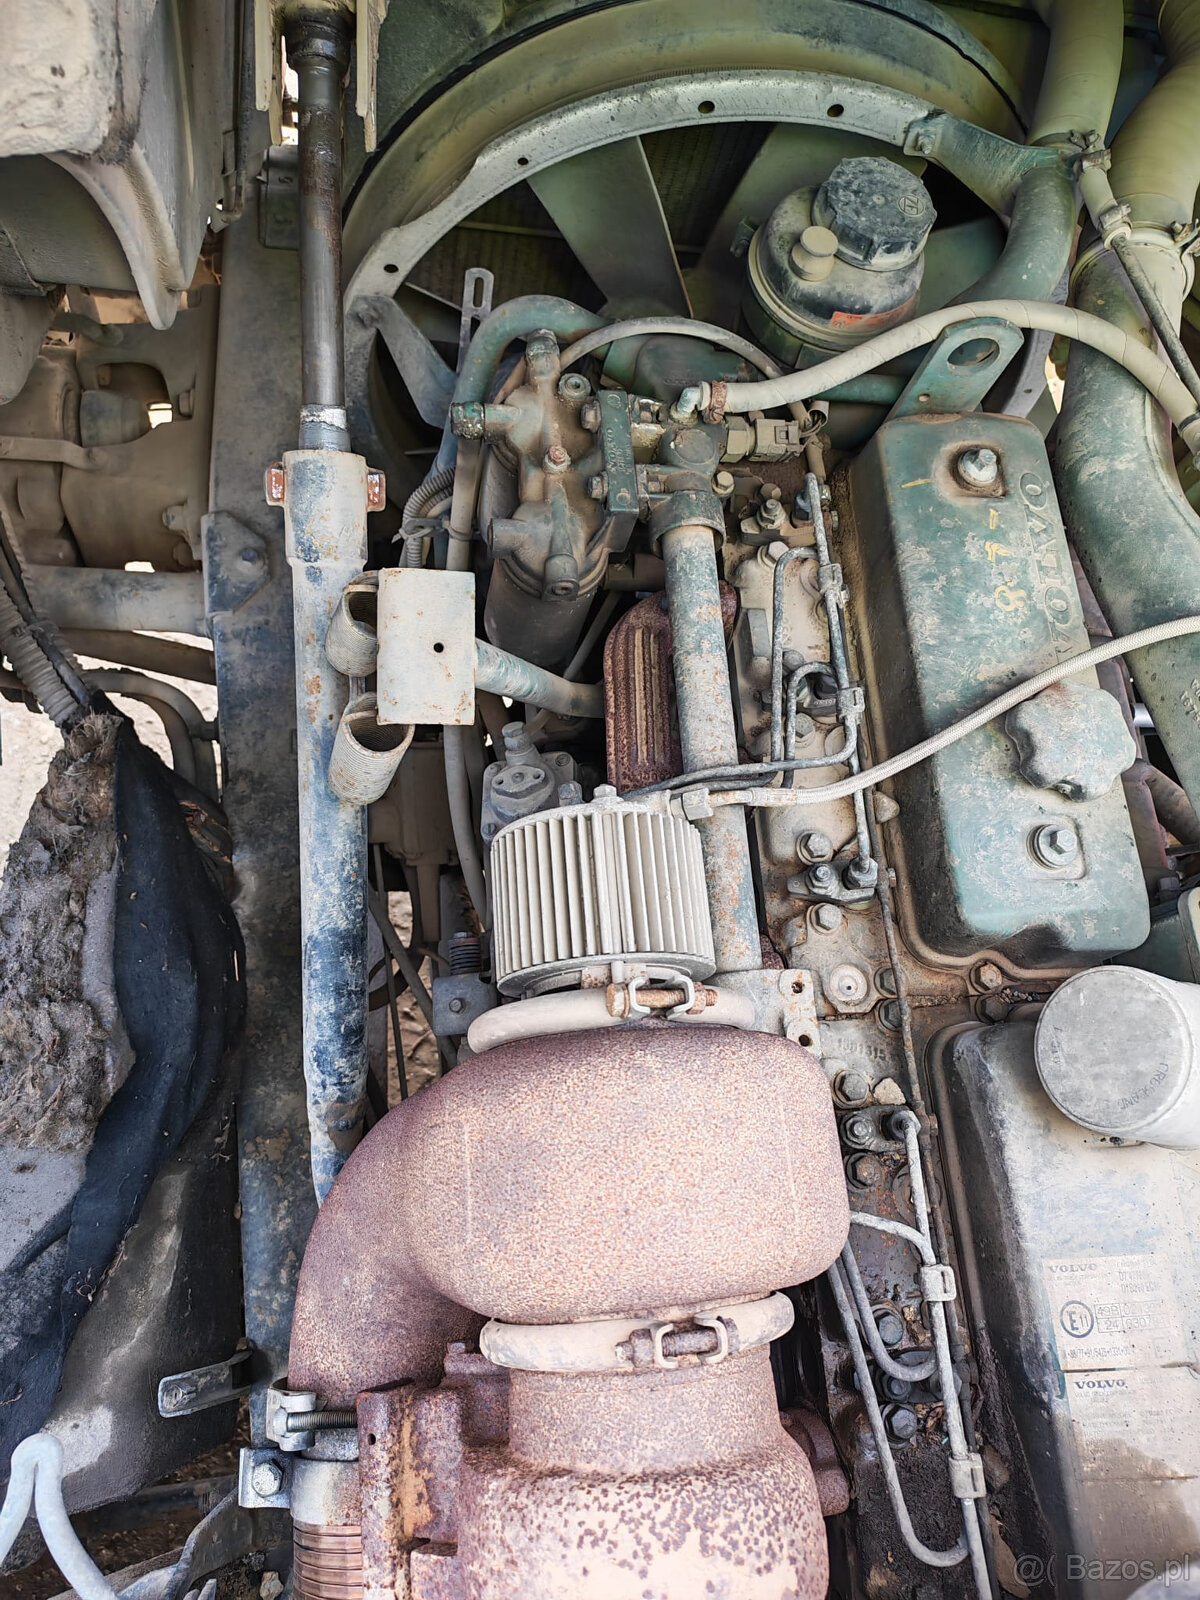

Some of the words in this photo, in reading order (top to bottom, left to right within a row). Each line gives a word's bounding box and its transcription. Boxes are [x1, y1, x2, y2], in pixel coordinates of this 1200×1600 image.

[1018, 471, 1078, 664] VOLVO
[1049, 1262, 1098, 1274] VOLVO
[1074, 1378, 1127, 1390] VOLVO
